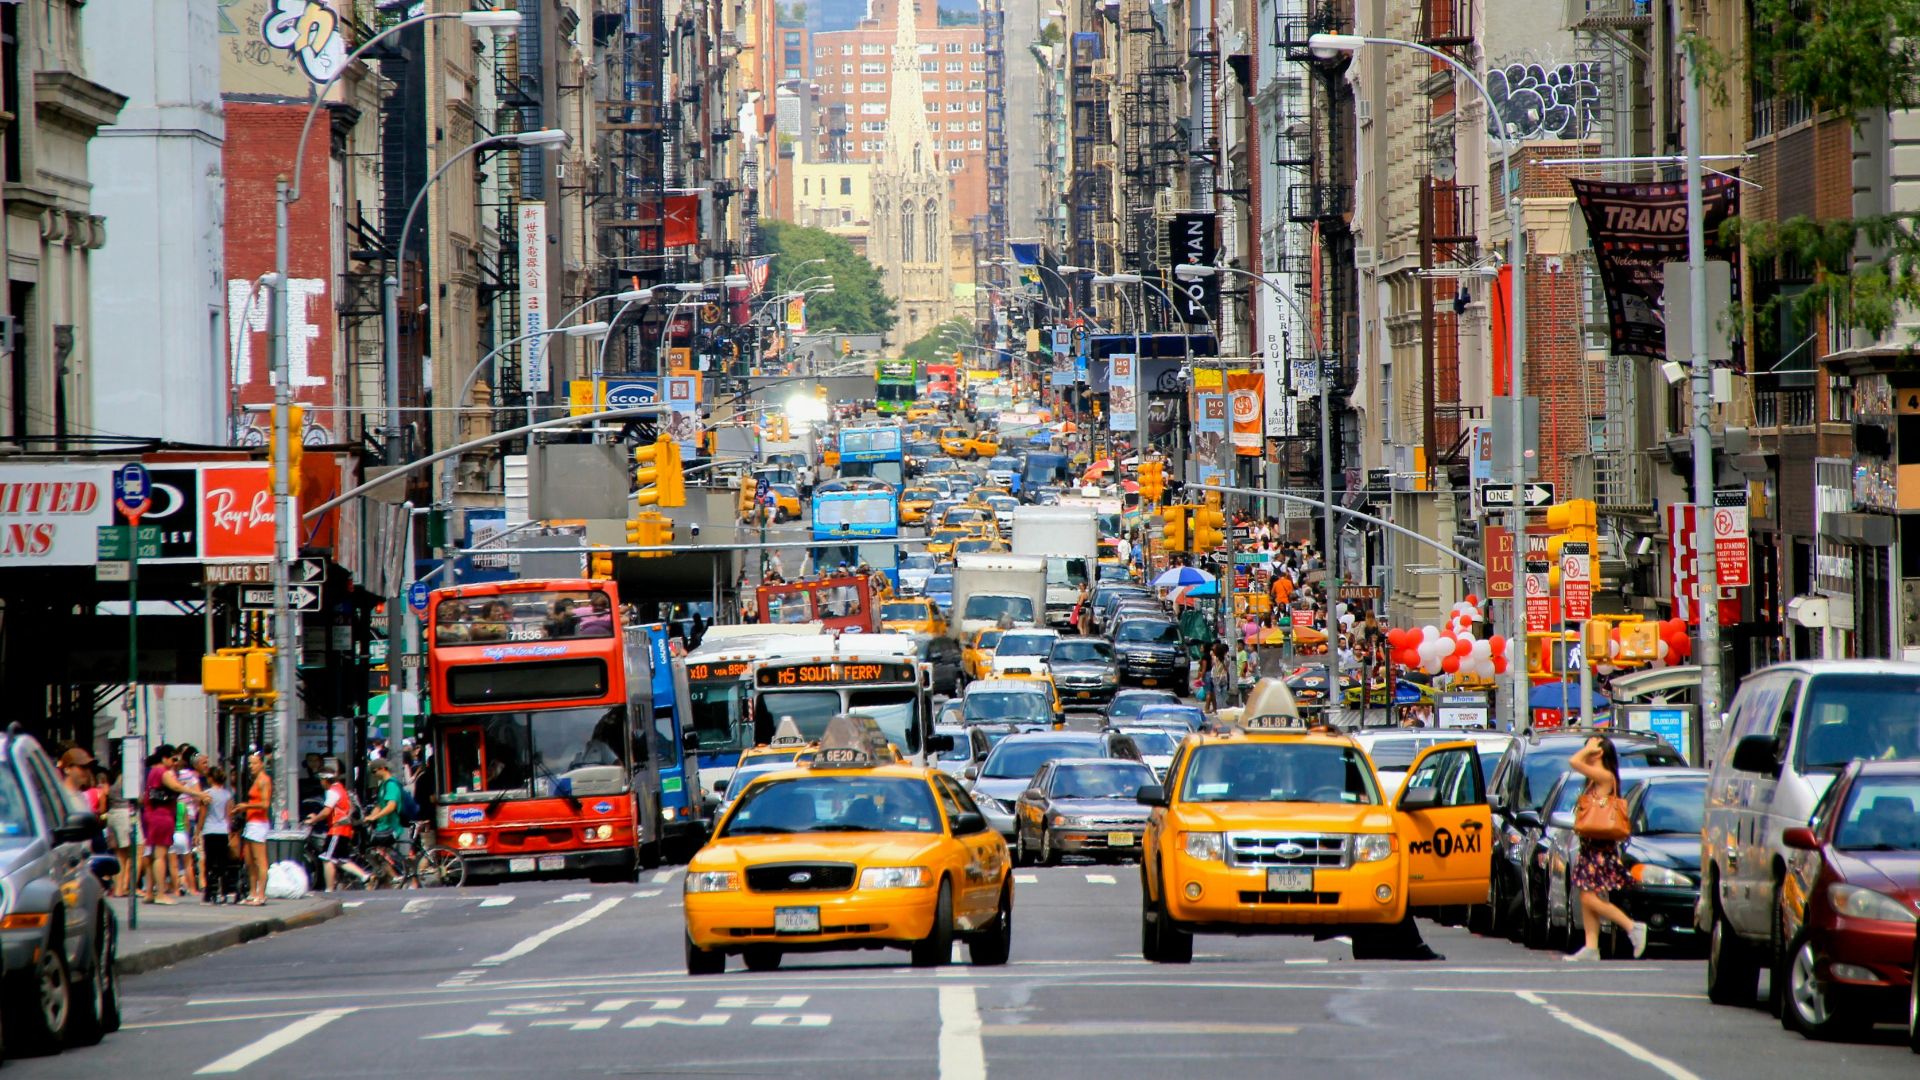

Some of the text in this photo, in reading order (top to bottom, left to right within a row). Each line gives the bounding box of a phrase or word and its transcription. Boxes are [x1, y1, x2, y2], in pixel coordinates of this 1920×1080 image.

[1603, 203, 1713, 233] TRANST
[1187, 220, 1205, 316] TOMAN
[528, 313, 540, 347] BROADAY
[1489, 491, 1509, 501] ONE
[1724, 542, 1746, 550] STANDING
[206, 565, 268, 581] WALKER ST
[1340, 587, 1378, 599] CANAL ST
[1494, 583, 1508, 592] 414
[252, 592, 274, 602] ONE
[510, 630, 542, 641] 71336
[778, 665, 883, 684] M5 SOUTH FERRY
[1261, 716, 1287, 728] 9L89
[826, 750, 853, 762] 6E20
[1408, 829, 1481, 857] NYC TAXI
